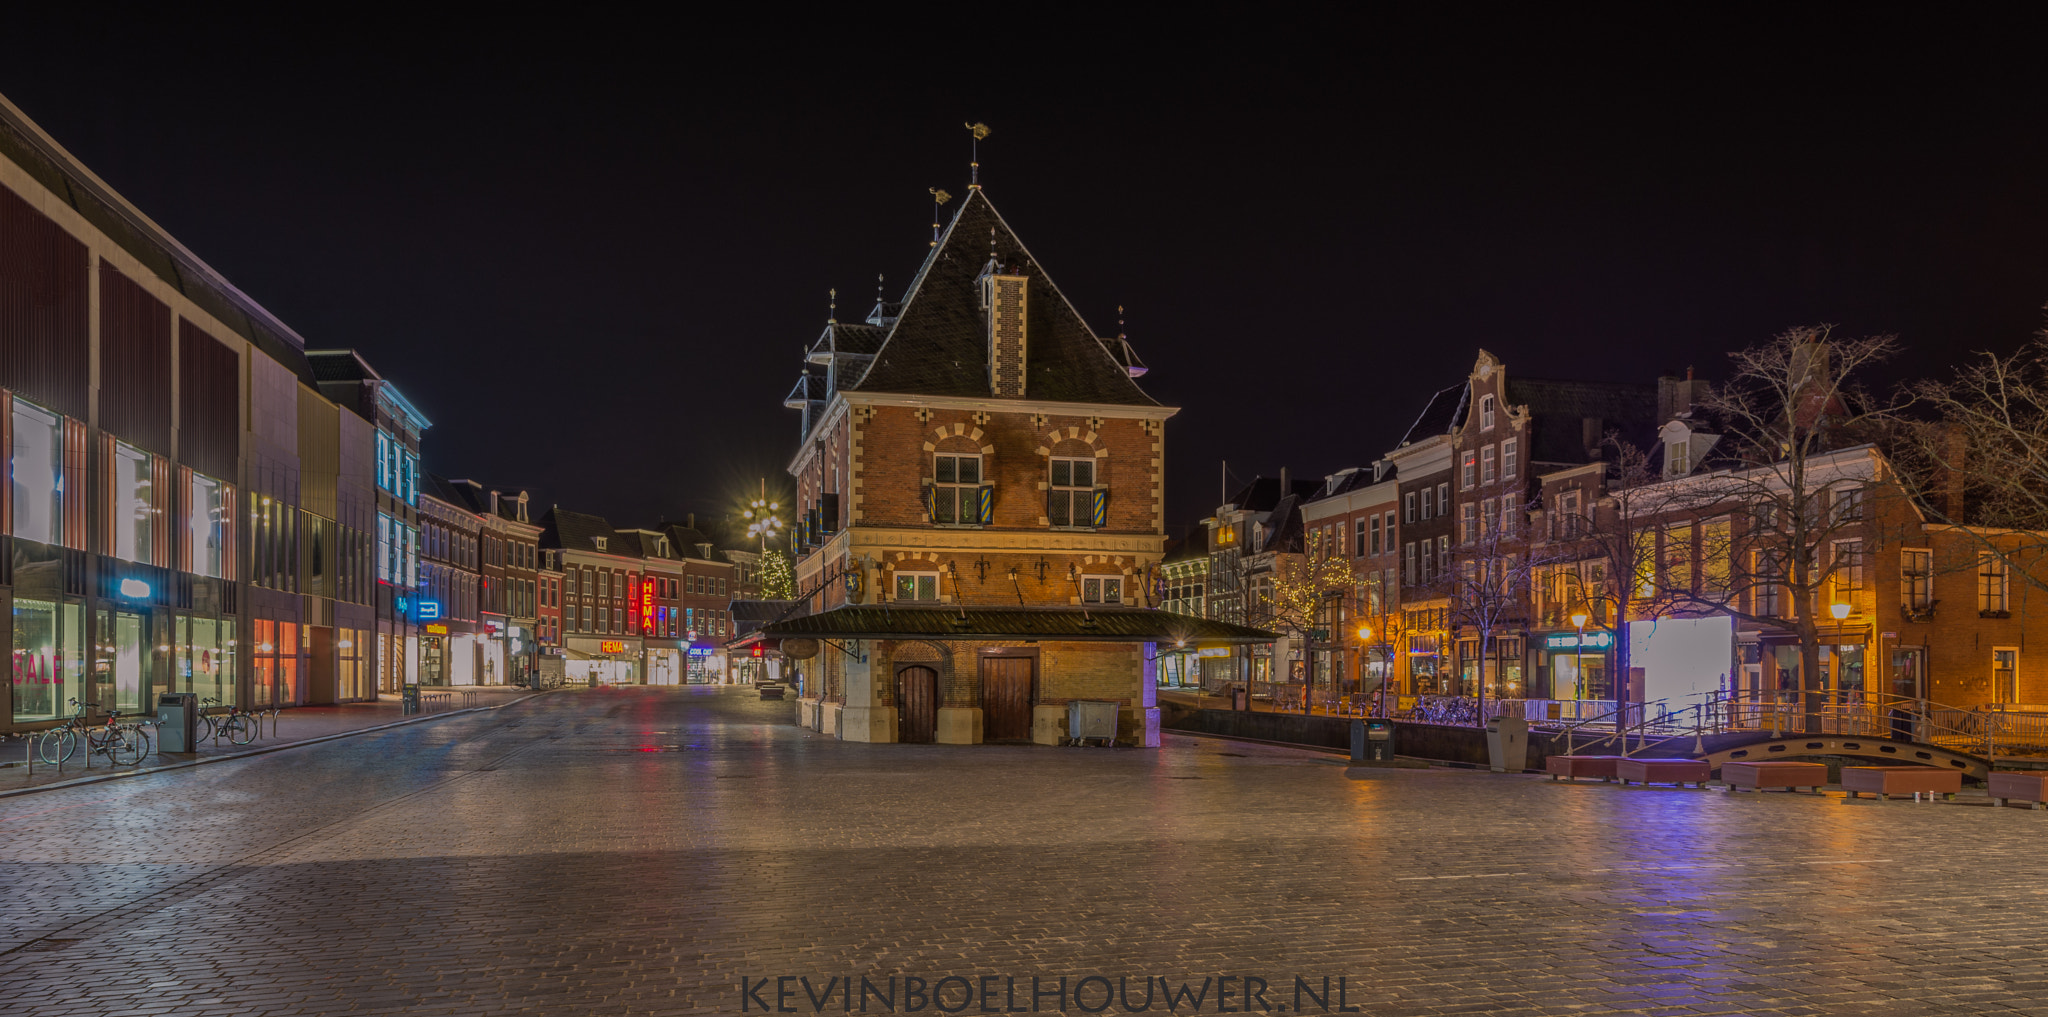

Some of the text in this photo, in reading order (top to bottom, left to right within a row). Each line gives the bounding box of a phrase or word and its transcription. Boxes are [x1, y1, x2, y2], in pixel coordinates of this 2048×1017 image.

[643, 582, 653, 628] HEMA
[602, 641, 623, 654] HEMA
[13, 653, 63, 685] SALE
